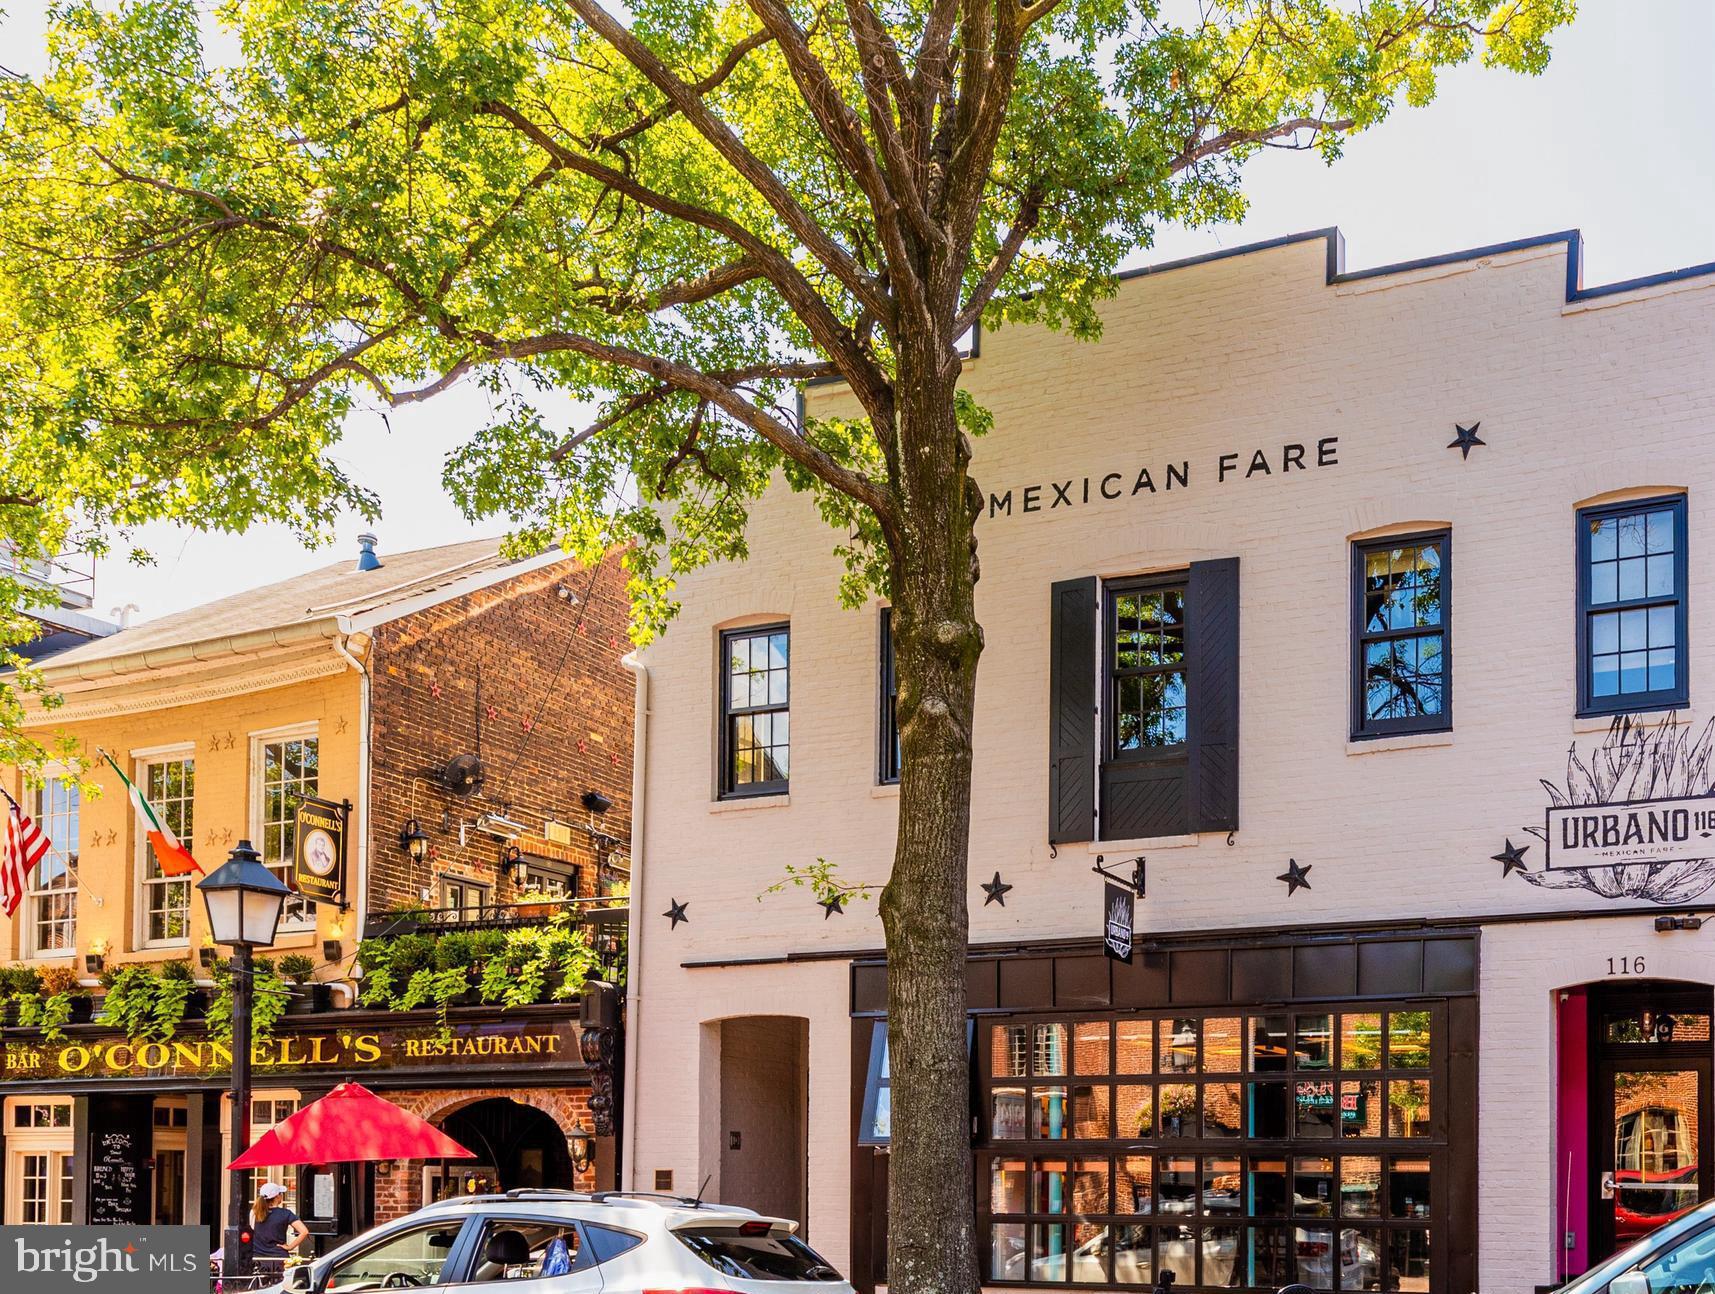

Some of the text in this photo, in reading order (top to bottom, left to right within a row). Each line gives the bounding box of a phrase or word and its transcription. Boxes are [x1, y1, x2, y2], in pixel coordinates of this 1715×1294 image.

[989, 437, 1339, 518] MEXICAN FARE
[300, 811, 342, 832] O'CONNELL'S
[1562, 809, 1689, 849] URBANO
[1602, 848, 1645, 857] MEXICAN
[298, 873, 339, 890] RESTAURANT
[1607, 956, 1645, 975] 116
[6, 1034, 561, 1072] BAR O'CONNELL'S RESTAURANT
